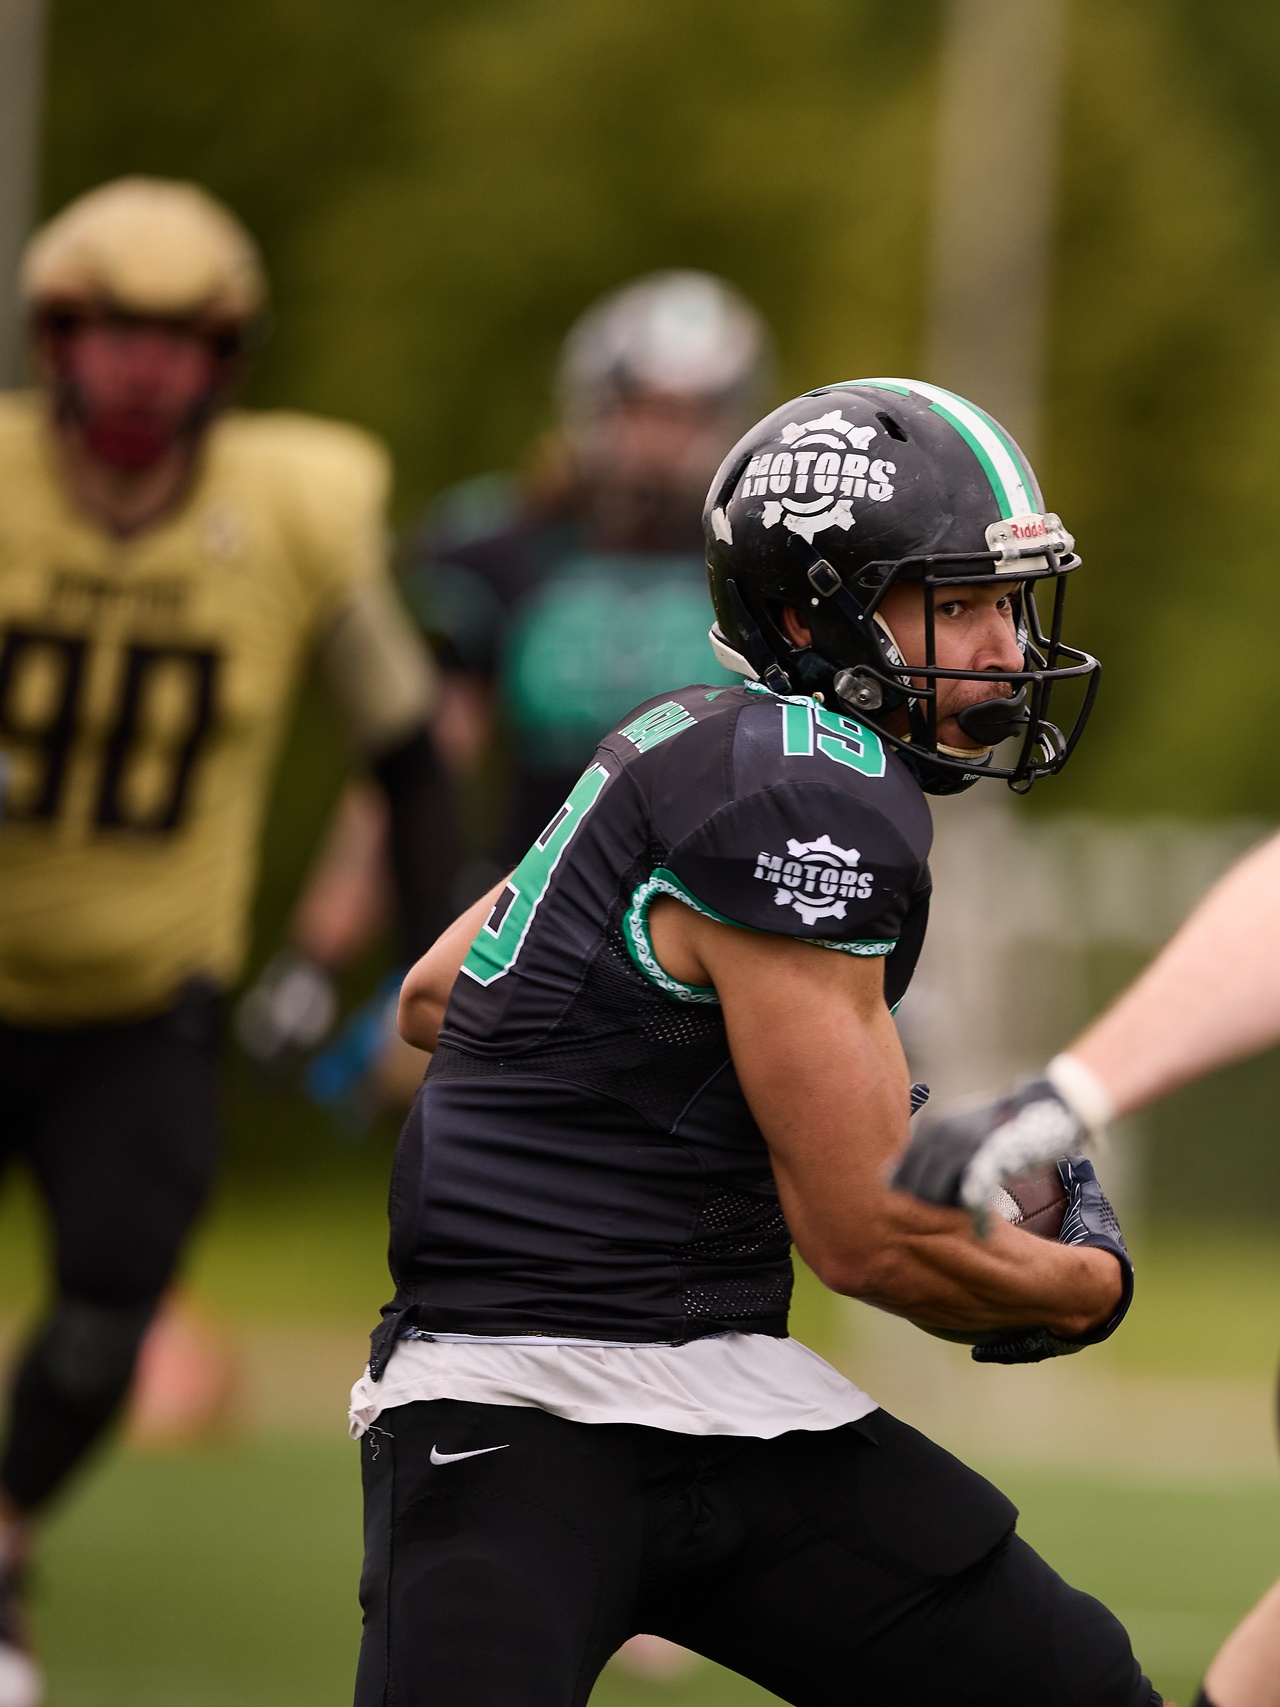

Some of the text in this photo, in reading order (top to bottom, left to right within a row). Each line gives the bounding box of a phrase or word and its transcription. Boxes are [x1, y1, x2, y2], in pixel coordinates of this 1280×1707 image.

[741, 451, 897, 502] MOTORS
[0, 630, 222, 836] 90
[776, 703, 887, 778] 19
[753, 851, 875, 899] MOTORS
